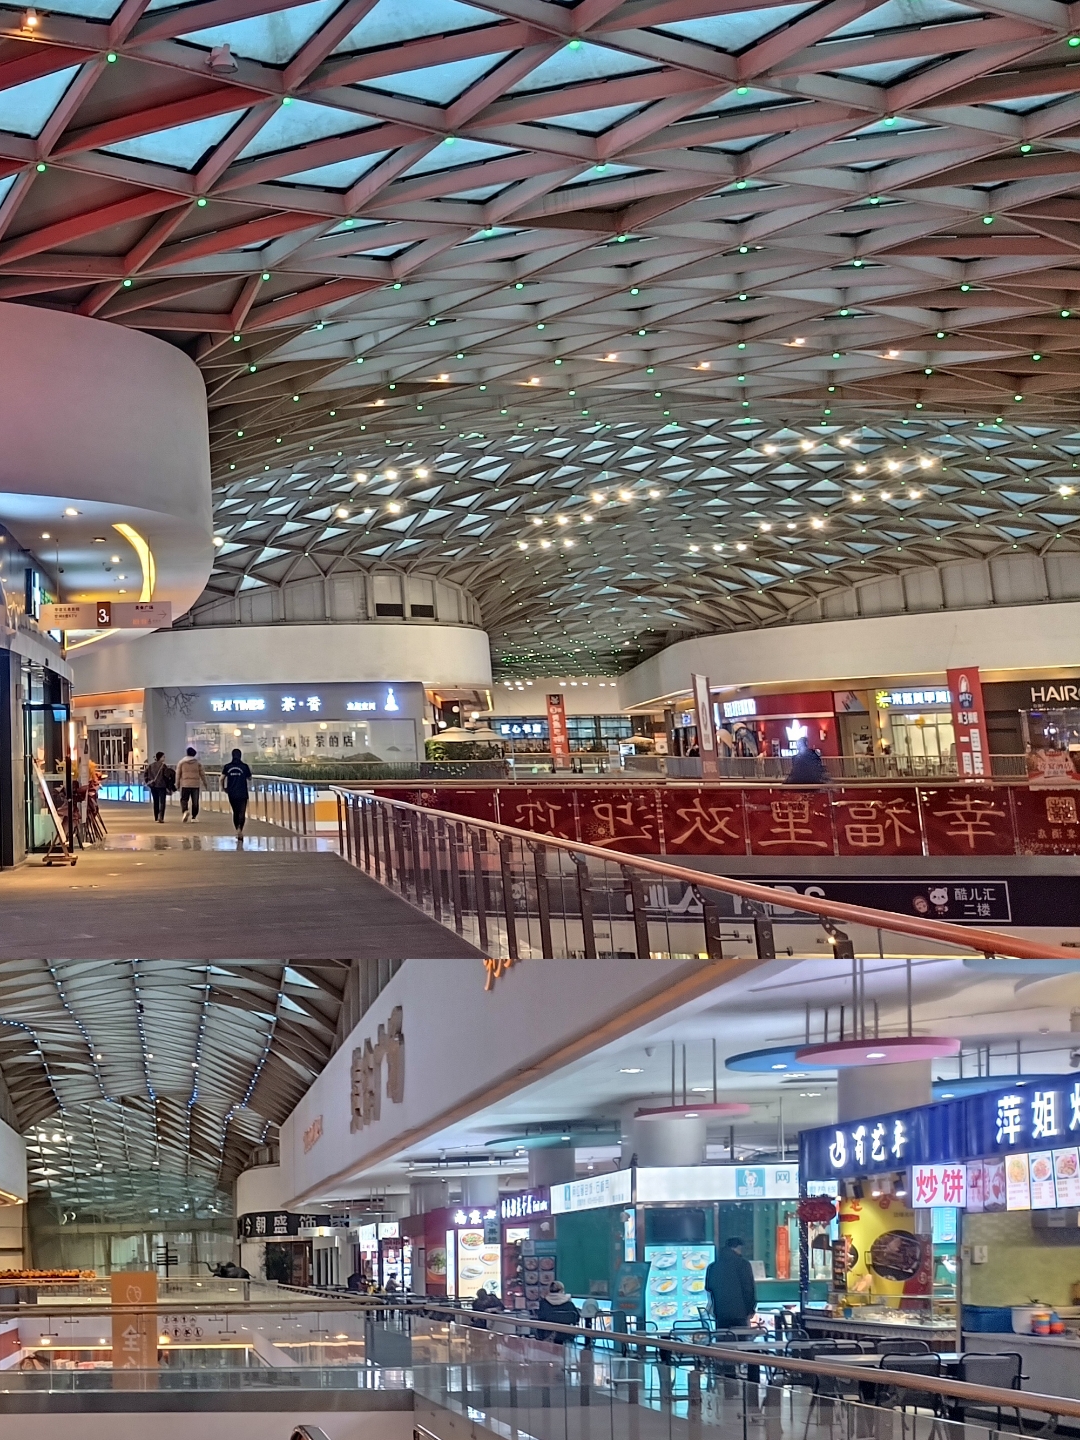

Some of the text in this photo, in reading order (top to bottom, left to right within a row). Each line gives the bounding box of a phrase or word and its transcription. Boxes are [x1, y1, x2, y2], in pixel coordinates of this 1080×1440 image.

[210, 699, 266, 712] TEA TIMES
[281, 696, 321, 712] 茶·香
[954, 888, 996, 901] 酷儿汇
[963, 903, 991, 917] 二楼
[915, 1168, 964, 1204] 炒饼
